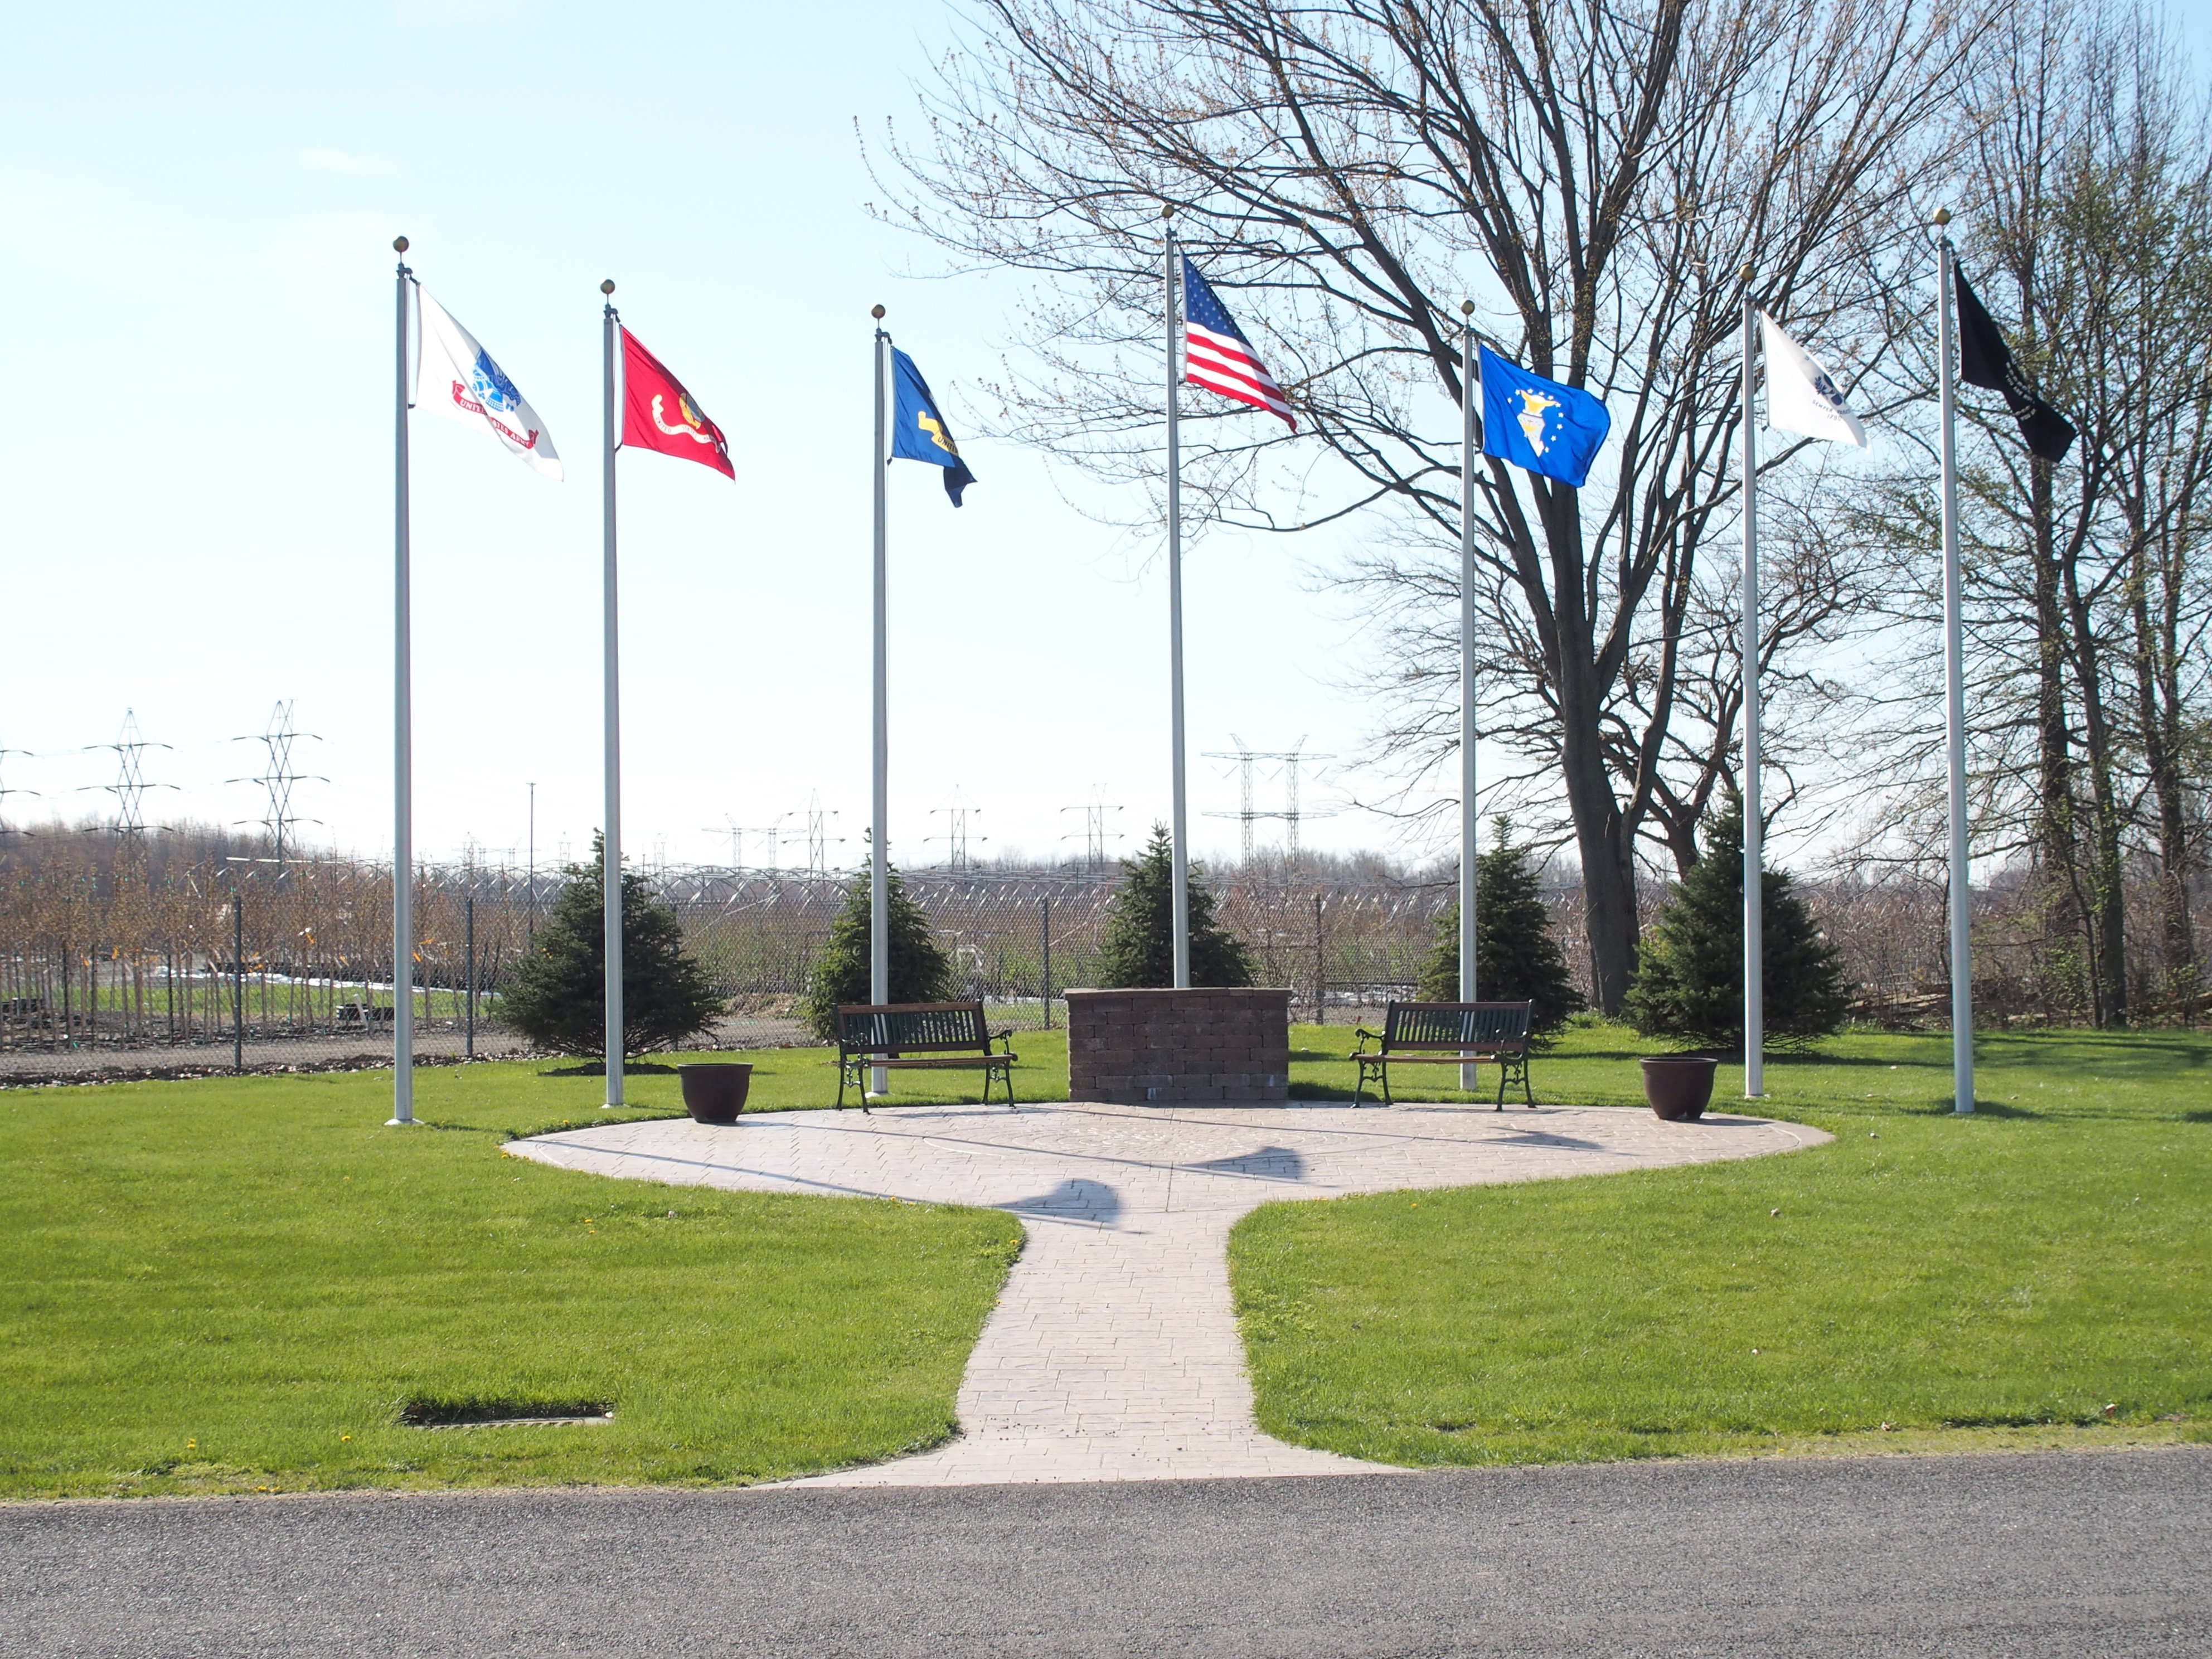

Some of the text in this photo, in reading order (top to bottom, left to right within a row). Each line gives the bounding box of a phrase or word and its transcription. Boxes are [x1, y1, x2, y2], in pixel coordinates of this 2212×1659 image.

[459, 399, 530, 447] UNITE ATES ARMY
